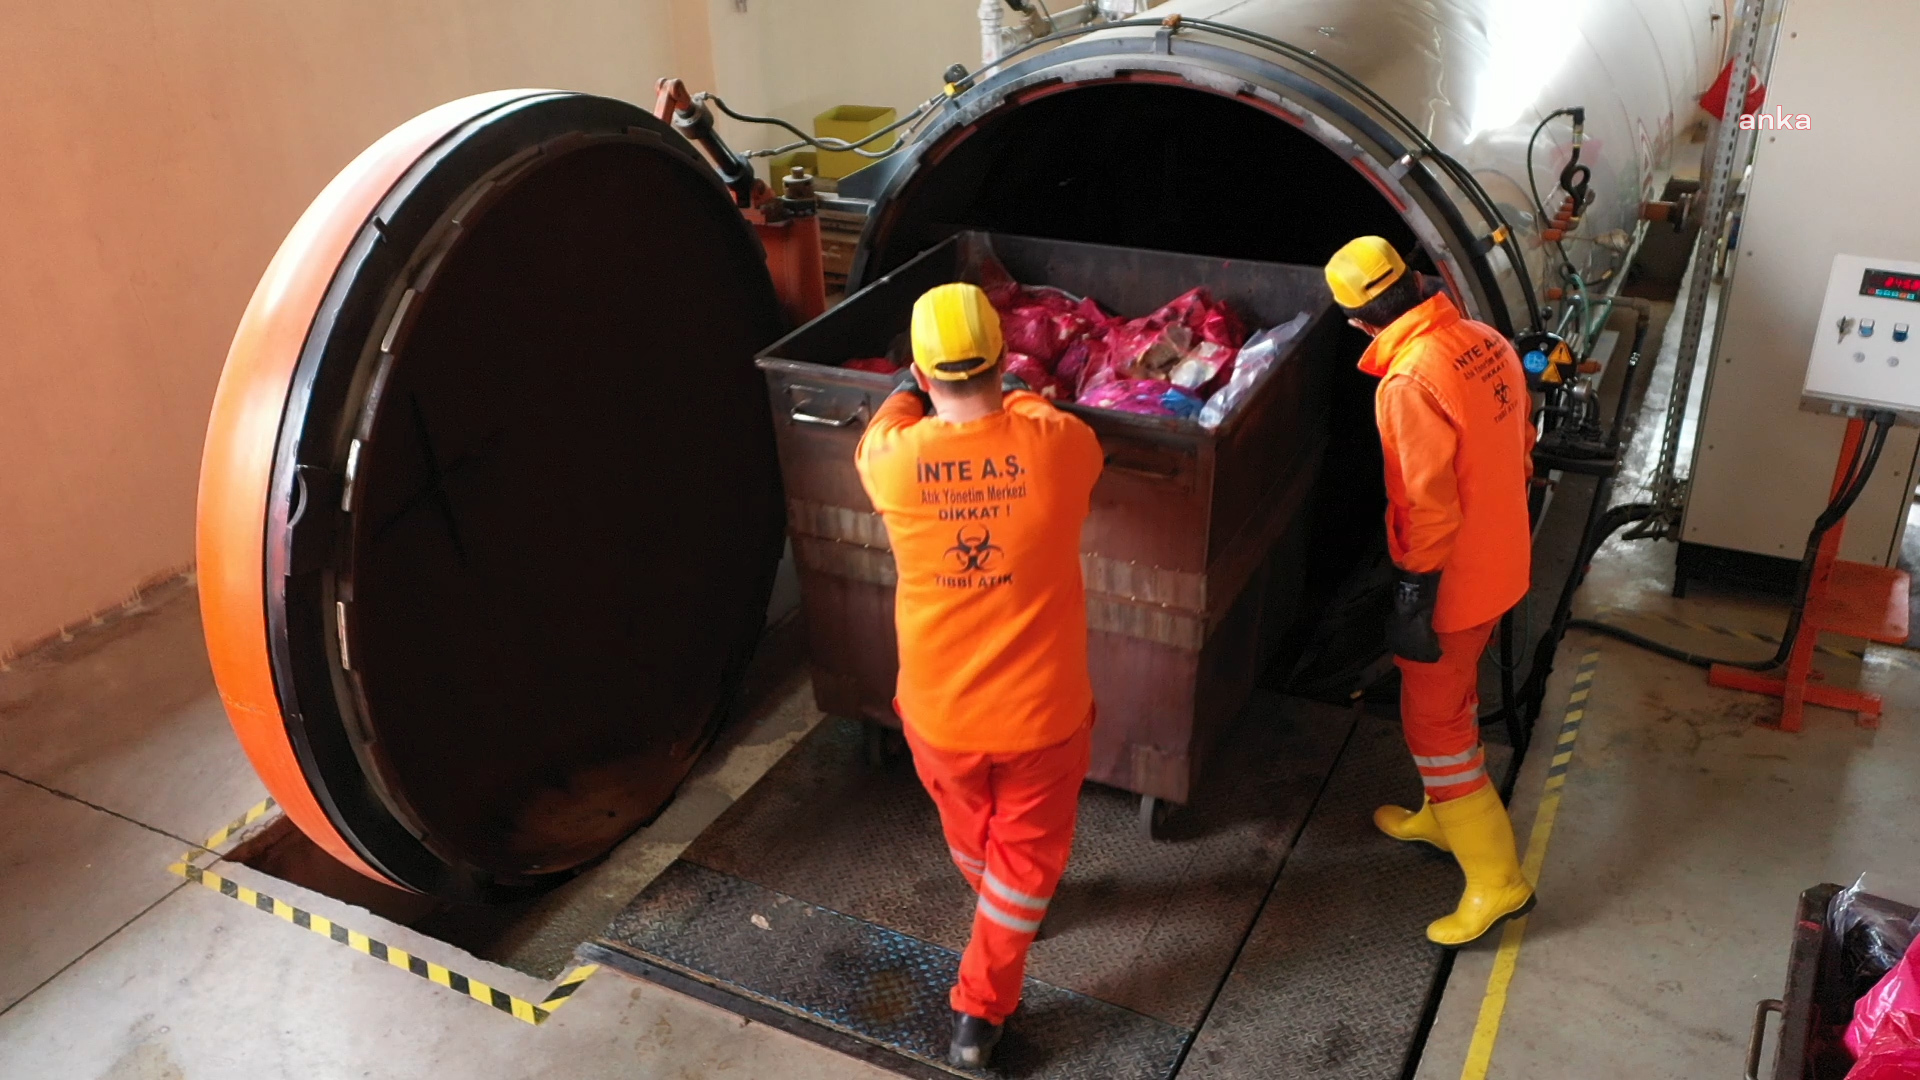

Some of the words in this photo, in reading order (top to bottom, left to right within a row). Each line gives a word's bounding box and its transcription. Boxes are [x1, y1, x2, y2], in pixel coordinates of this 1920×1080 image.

[916, 456, 973, 483] İNTE
[981, 454, 1026, 483] A.Ş.
[943, 486, 985, 504] Yönetim
[987, 482, 1027, 501] Merkezi
[938, 506, 1000, 521] DİKKAT
